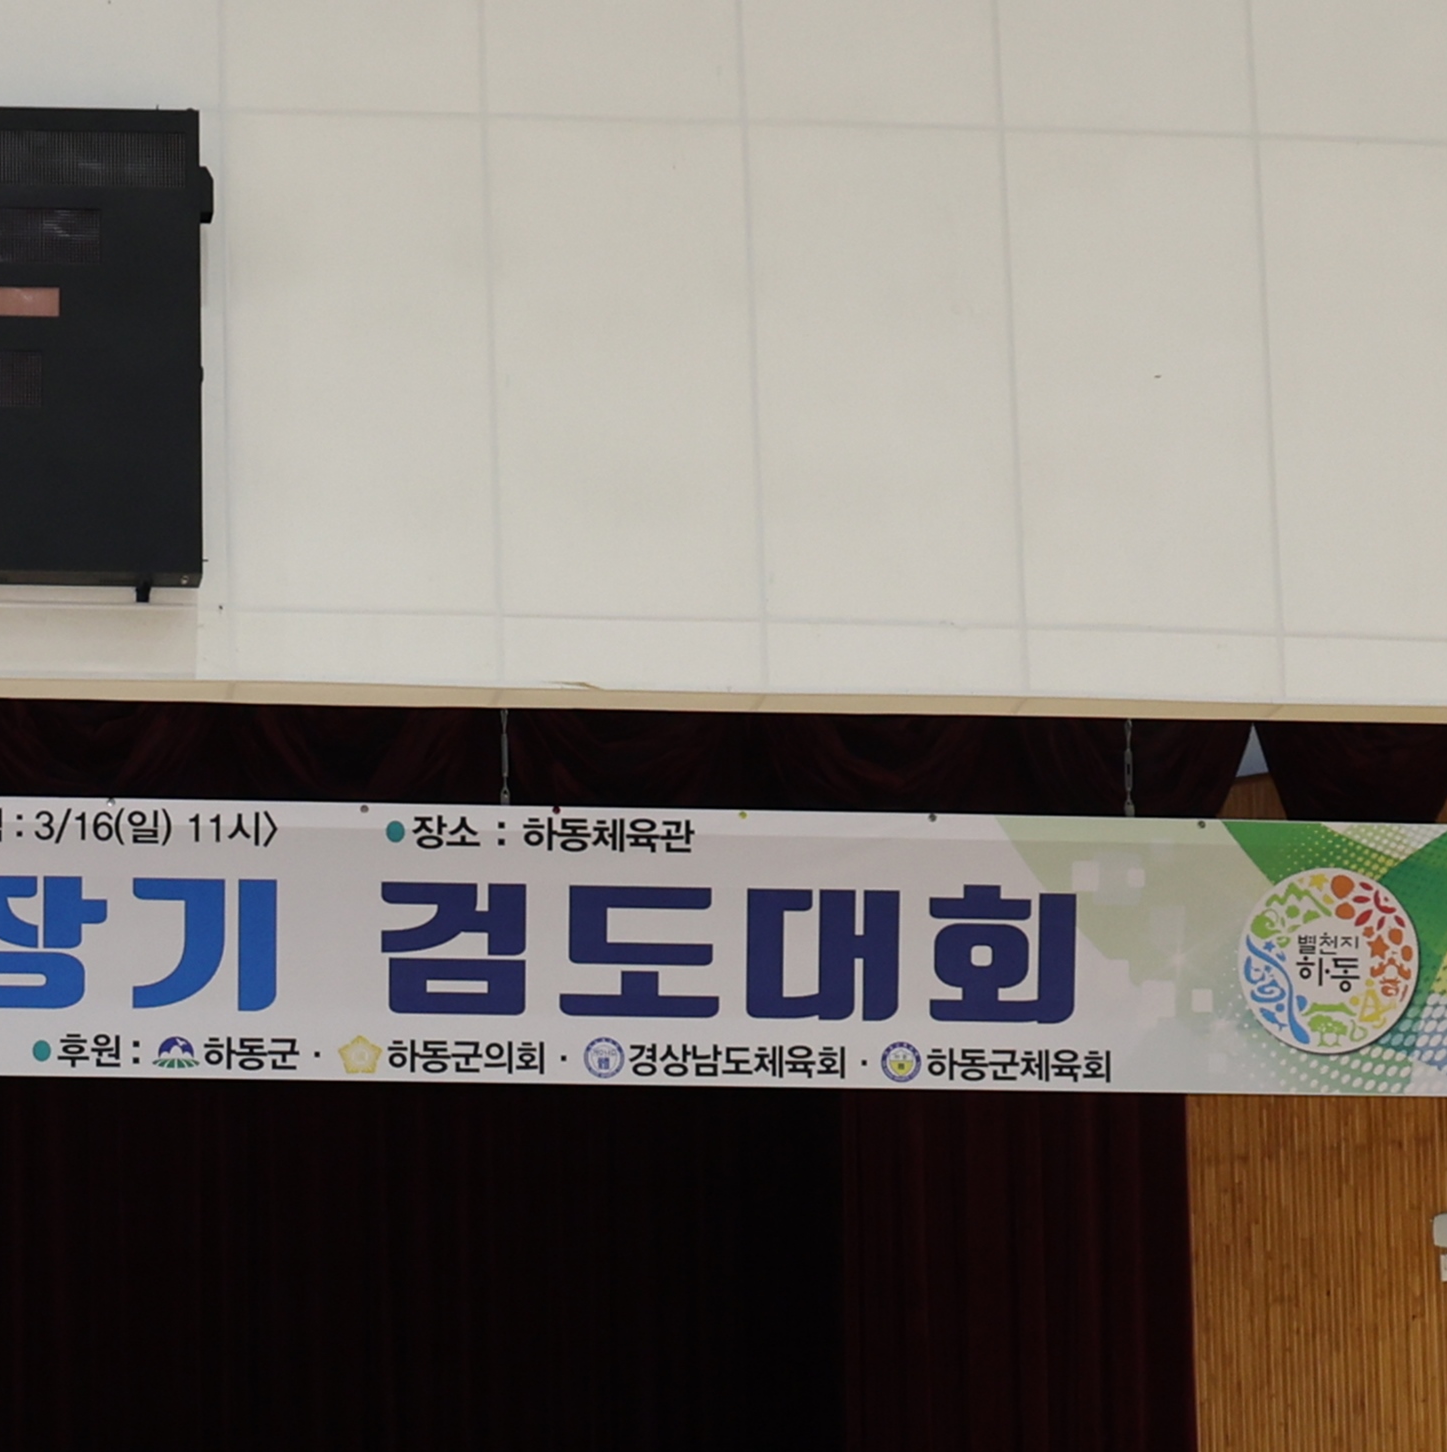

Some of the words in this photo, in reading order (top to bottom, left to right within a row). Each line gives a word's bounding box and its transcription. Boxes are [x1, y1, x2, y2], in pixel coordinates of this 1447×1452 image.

[412, 815, 481, 849] 장소
[523, 816, 695, 853] 하동체육관
[381, 881, 1077, 1024] 검도대회
[1298, 930, 1359, 955] 별천지
[1296, 956, 1360, 993] 하동
[57, 1034, 121, 1068] 후원
[204, 1037, 299, 1070] 하동군
[388, 1039, 544, 1075] 하동군의회
[629, 1043, 846, 1080] 경상남도체육회
[927, 1048, 1111, 1083] 하동군체육회
